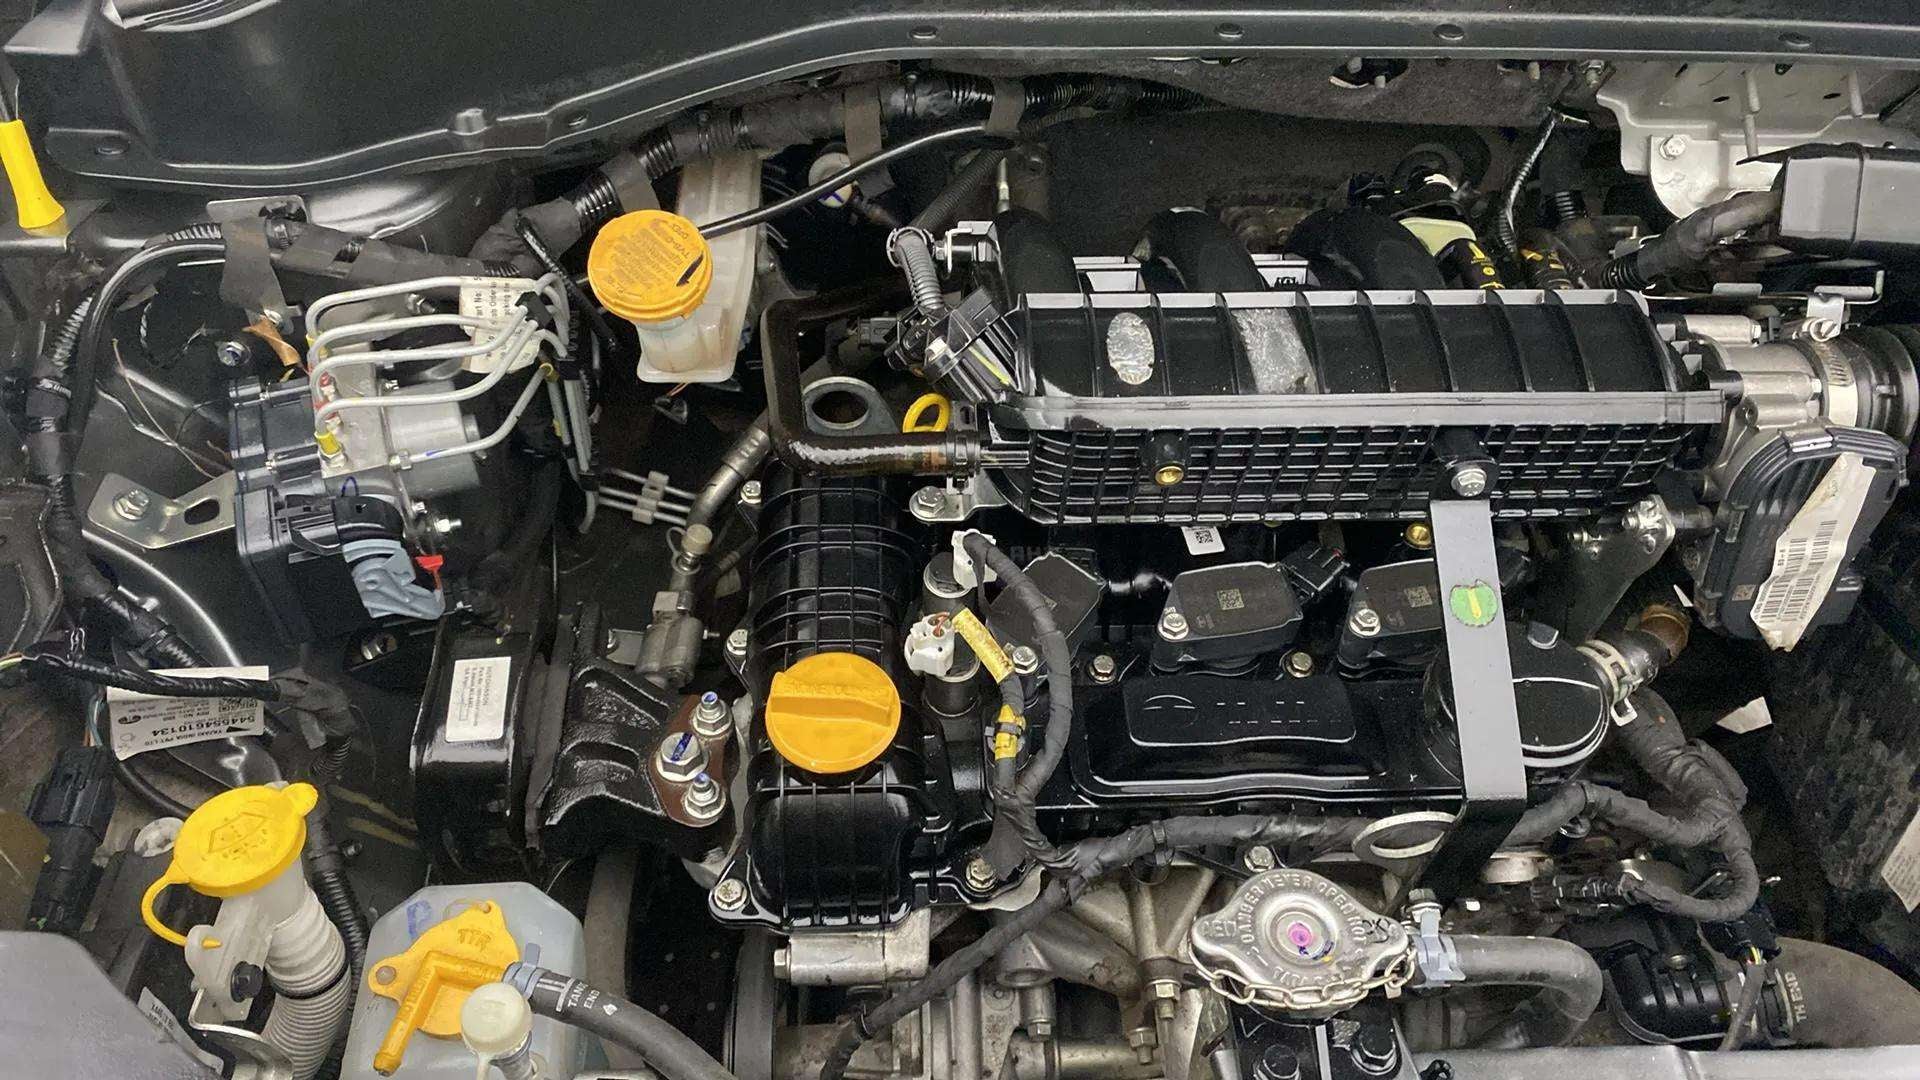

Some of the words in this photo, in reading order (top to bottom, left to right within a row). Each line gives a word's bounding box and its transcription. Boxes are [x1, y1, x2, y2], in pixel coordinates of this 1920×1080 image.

[567, 981, 590, 1009] TANK
[583, 988, 601, 1010] END
[1784, 971, 1803, 1002] END
